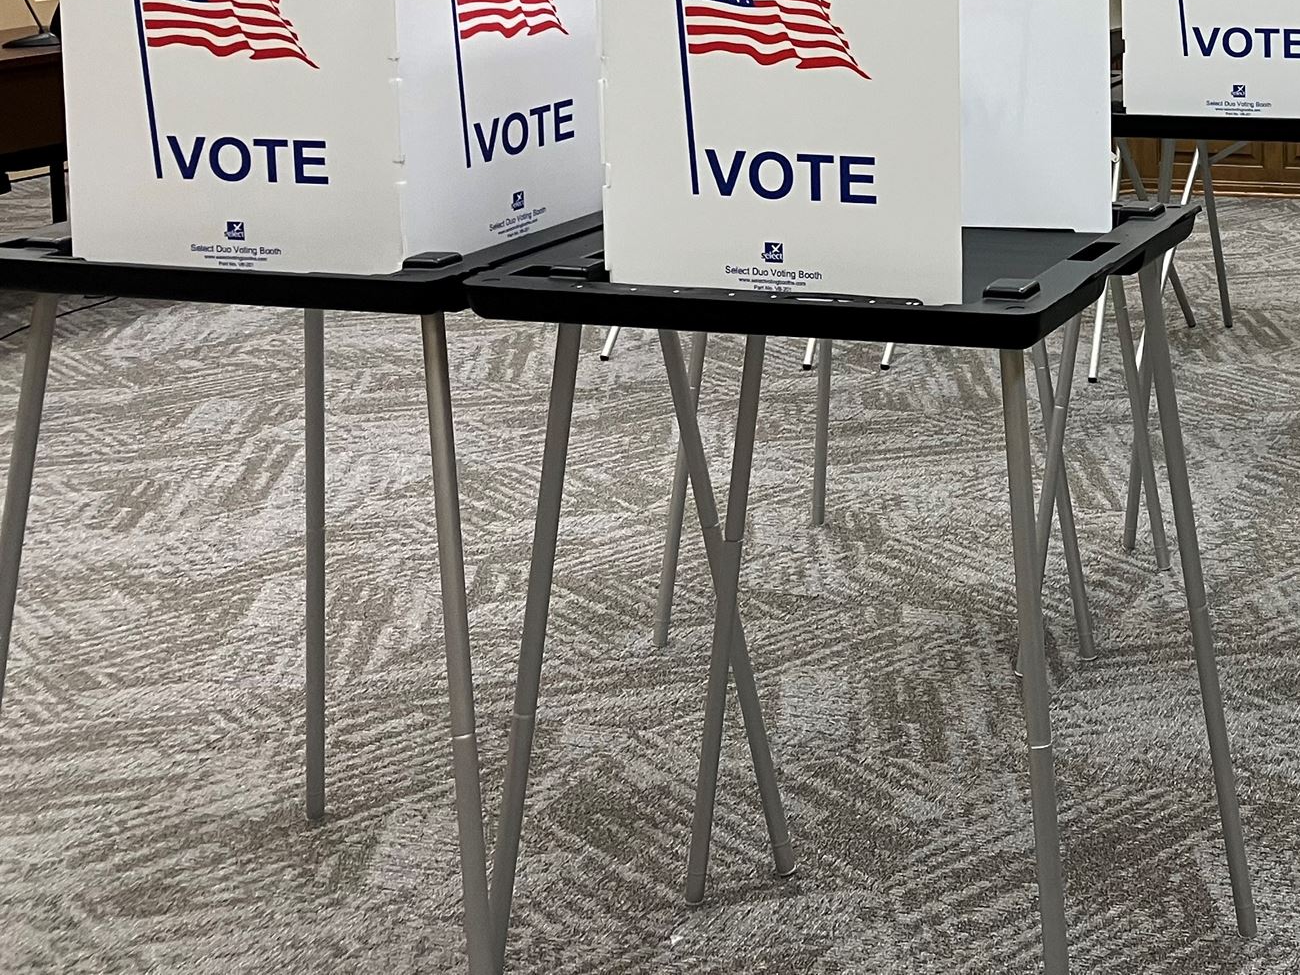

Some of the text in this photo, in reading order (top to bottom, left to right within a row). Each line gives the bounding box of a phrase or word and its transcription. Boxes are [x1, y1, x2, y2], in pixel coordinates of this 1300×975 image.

[474, 98, 576, 163] VOTE
[166, 136, 330, 185] VOTE
[704, 149, 878, 205] VOTE
[191, 244, 282, 255] Select Duo Voting Booth
[761, 251, 783, 260] select
[725, 266, 822, 280] Select Duo Voting Booth
